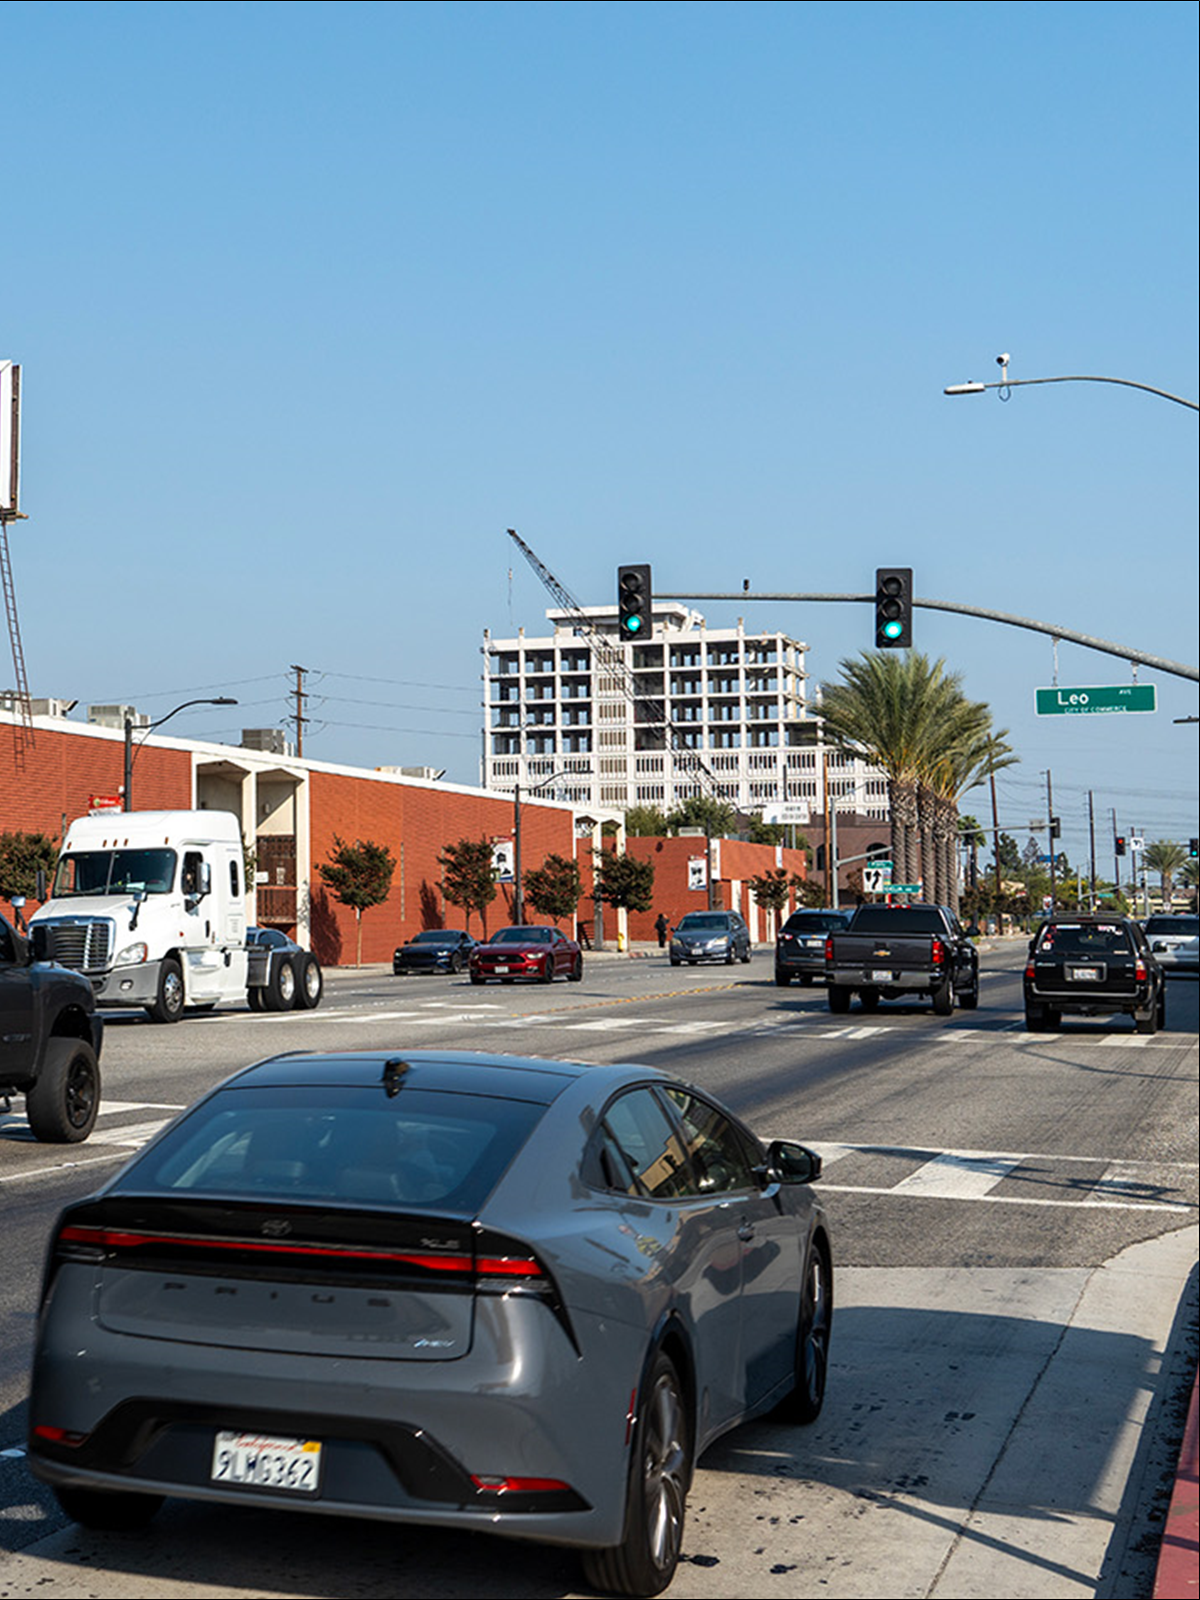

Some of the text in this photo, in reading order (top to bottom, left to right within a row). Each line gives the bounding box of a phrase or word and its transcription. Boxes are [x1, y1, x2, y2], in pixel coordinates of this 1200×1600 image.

[1057, 691, 1089, 705] Leo
[1090, 704, 1127, 713] COMMERCE
[163, 1281, 392, 1308] PRIUS
